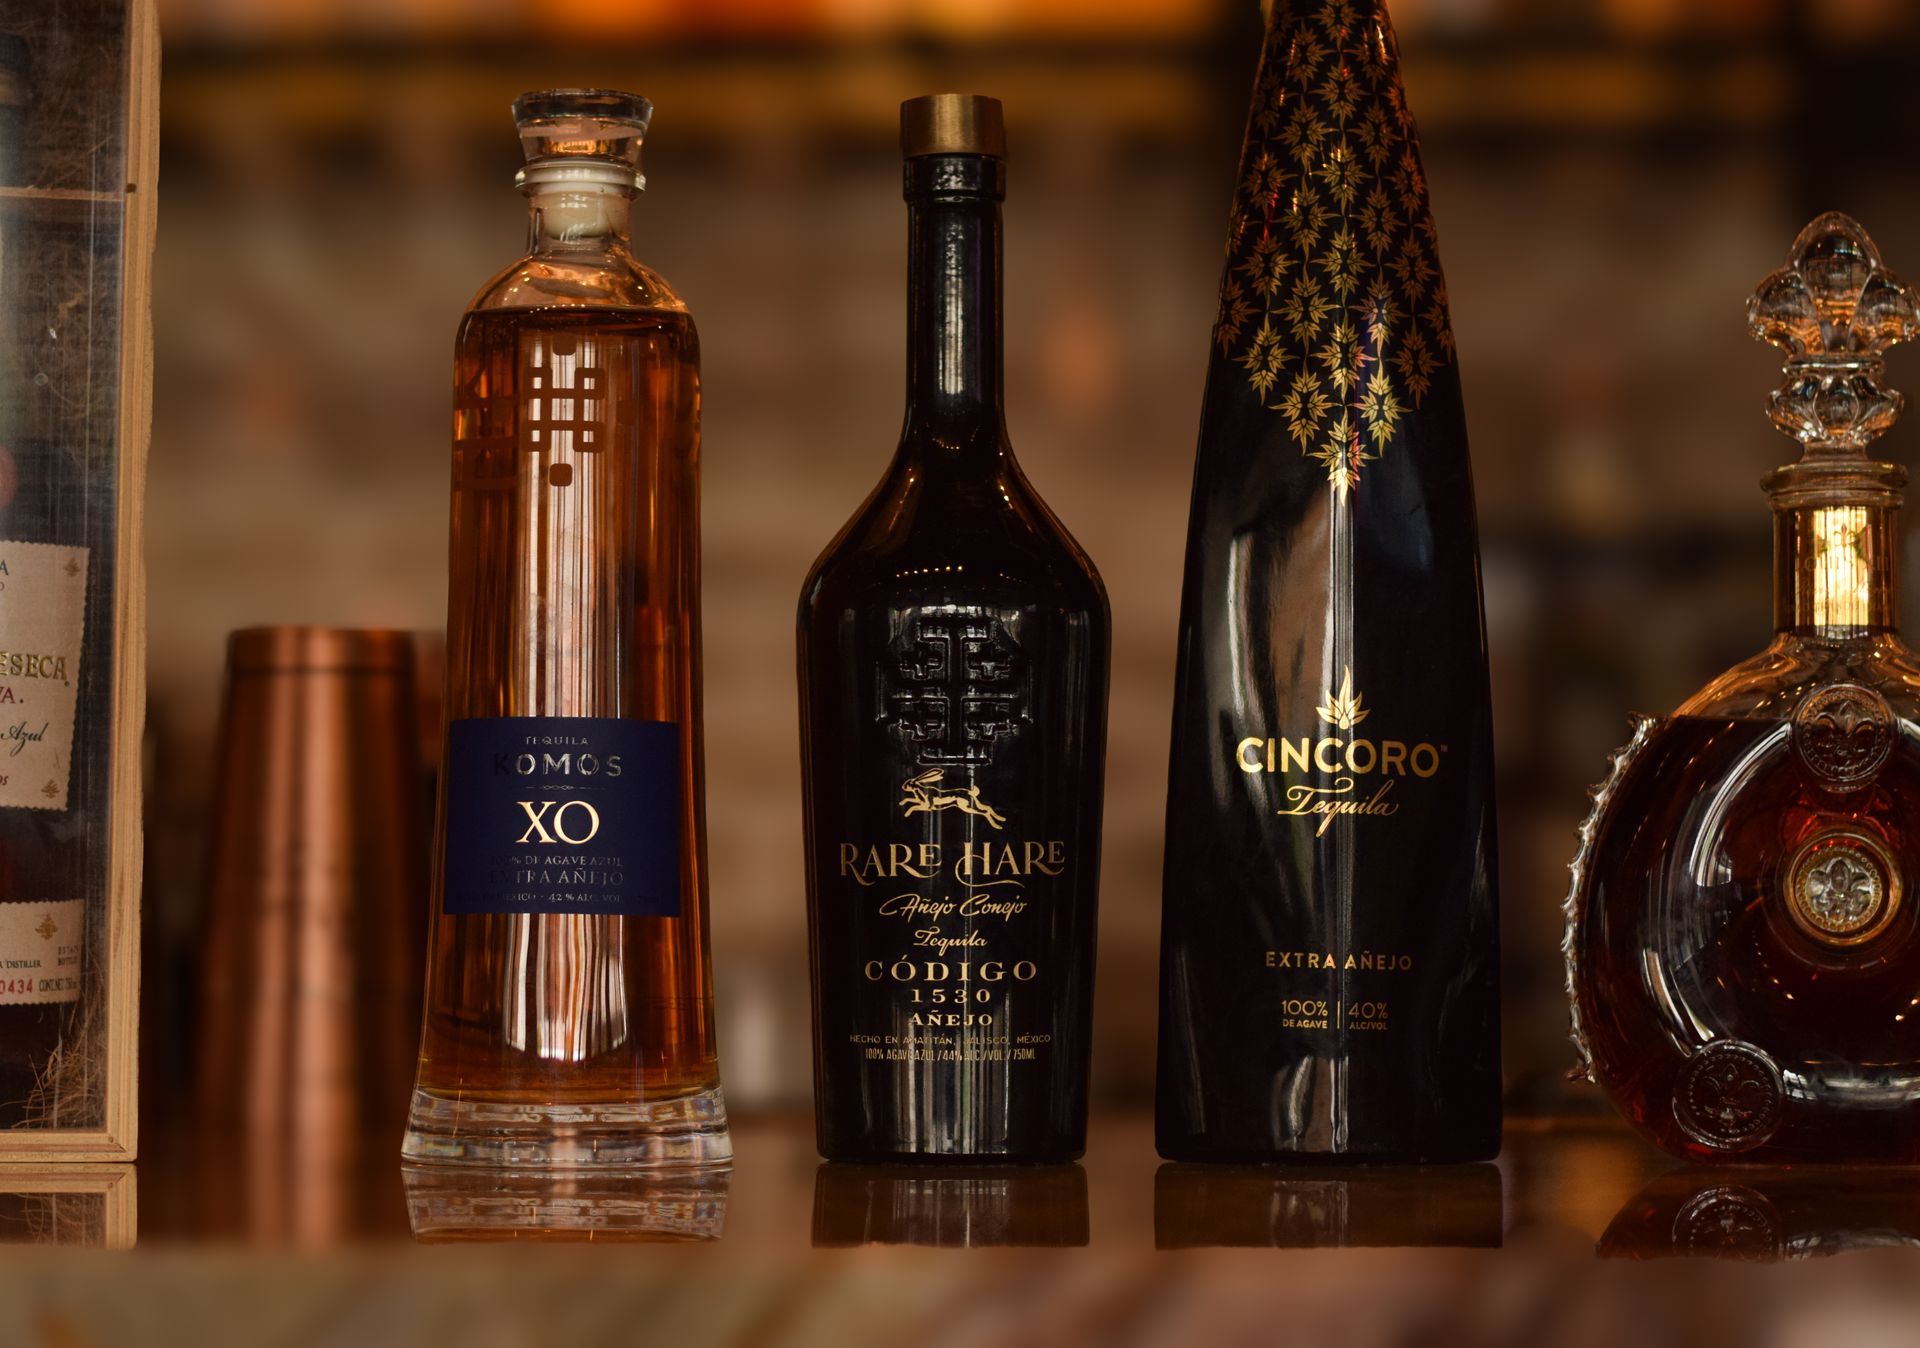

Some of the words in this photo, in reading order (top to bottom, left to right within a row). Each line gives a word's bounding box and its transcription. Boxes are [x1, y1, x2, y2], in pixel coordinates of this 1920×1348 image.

[525, 735, 590, 745] TEQUILA
[494, 752, 623, 777] KOMOS
[1277, 776, 1400, 838] Tequila
[516, 800, 600, 845] XO
[544, 855, 588, 866] AGAVE
[839, 842, 942, 886] RARE
[955, 841, 1066, 888] HARE
[879, 893, 958, 923] Añejo
[959, 893, 1028, 922] Conejo
[912, 926, 988, 956] Tequila
[864, 954, 1037, 982] CÓDIGO
[1265, 951, 1336, 969] EXTRA
[1344, 950, 1412, 971] AÑEJO
[911, 988, 991, 1004] 1530
[1281, 1000, 1329, 1017] 100%
[1348, 1002, 1389, 1019] 40%
[911, 1009, 993, 1027] AÑEJO
[1282, 1019, 1295, 1028] DE
[1296, 1020, 1328, 1029] AGAVE
[1349, 1021, 1389, 1030] ALC/VOL
[849, 1034, 881, 1044] HECHO
[885, 1036, 898, 1045] EN
[1016, 1032, 1051, 1045] MÉXICO
[865, 1048, 884, 1061] 100%
[886, 1048, 913, 1061] AGAVE
[914, 1049, 935, 1062] AZUL
